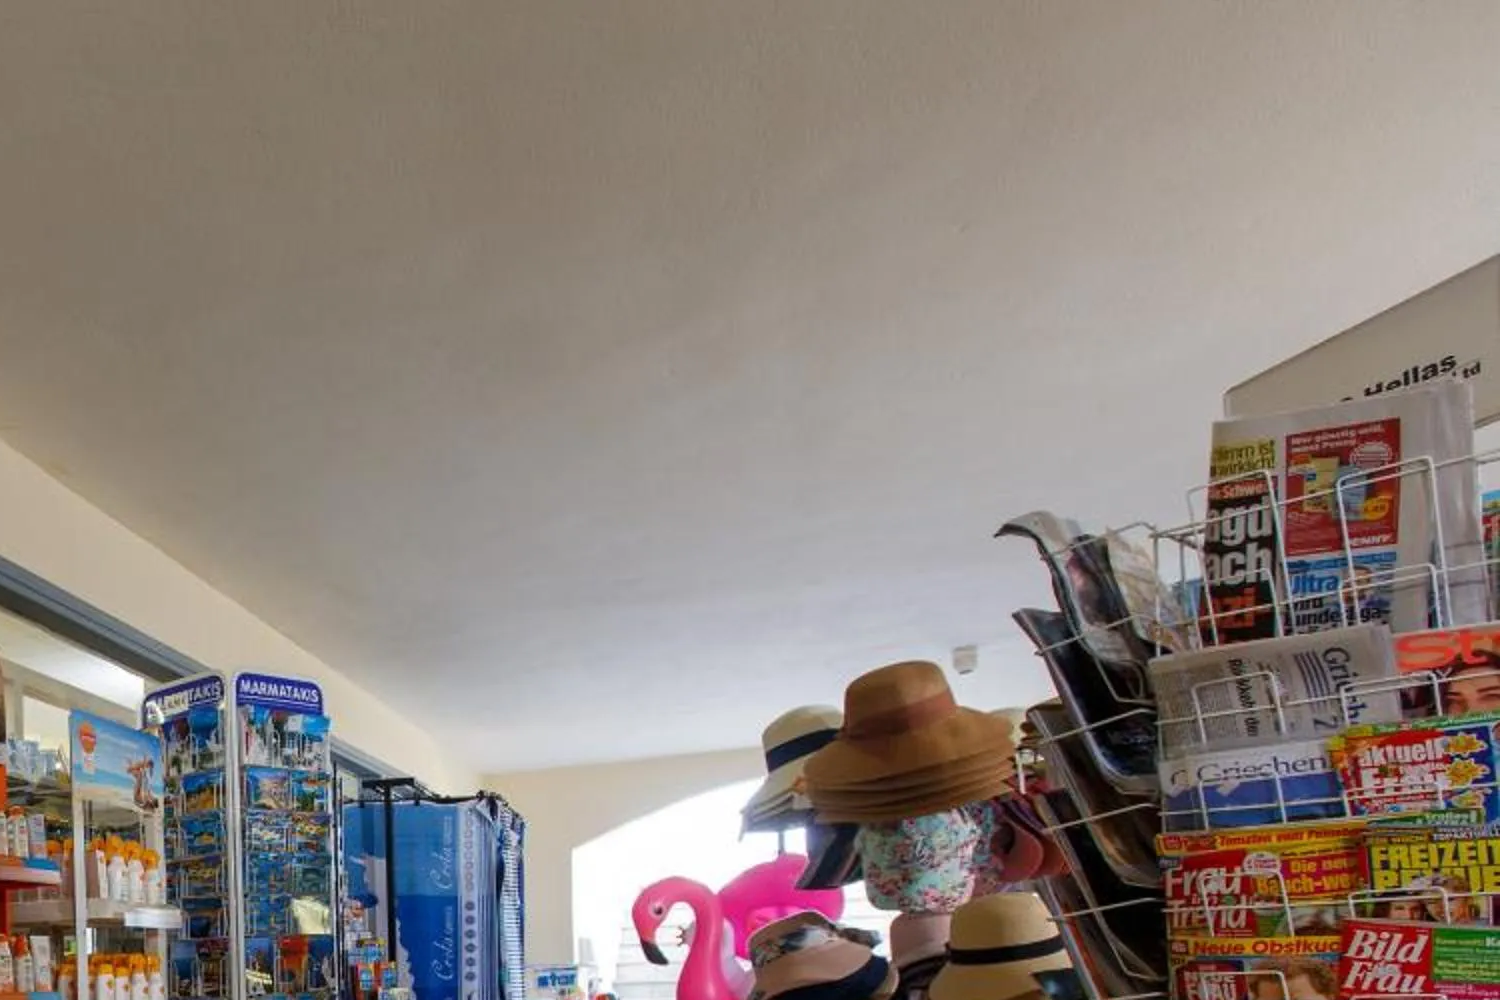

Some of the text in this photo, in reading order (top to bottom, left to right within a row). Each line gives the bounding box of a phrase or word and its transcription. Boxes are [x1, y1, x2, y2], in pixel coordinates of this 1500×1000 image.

[239, 679, 320, 704] MARMATAKIS
[1164, 864, 1245, 898] Frau
[1343, 928, 1430, 963] Bild
[1341, 959, 1427, 993] Frau
